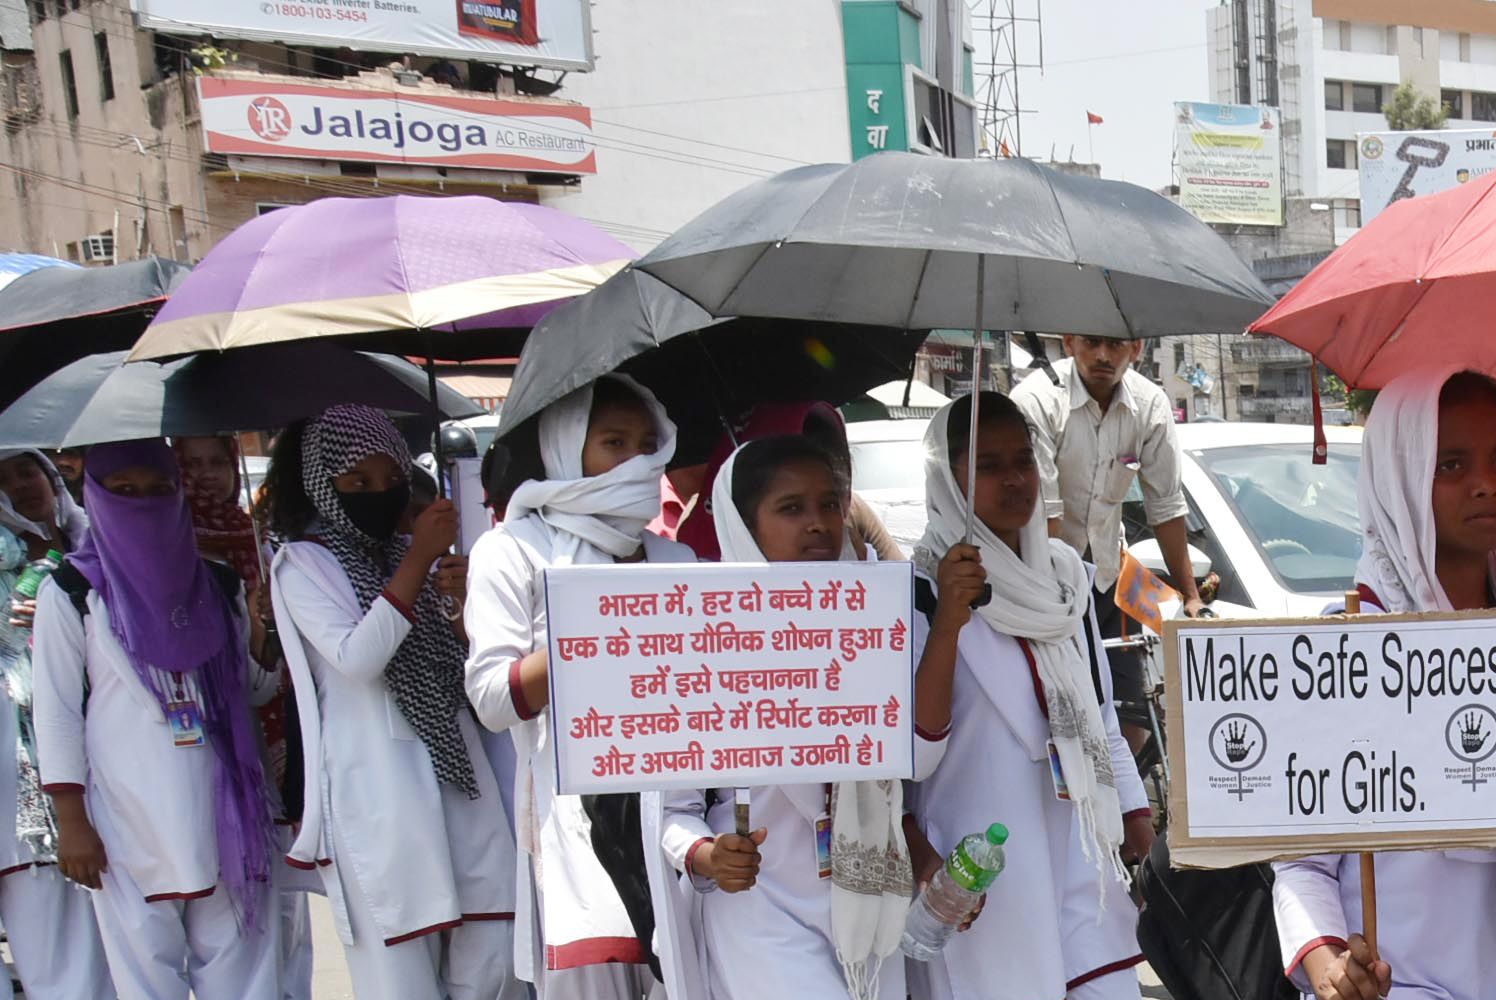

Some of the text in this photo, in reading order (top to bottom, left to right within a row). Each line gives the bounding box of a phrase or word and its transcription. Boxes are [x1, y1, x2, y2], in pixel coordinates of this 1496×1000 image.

[275, 4, 368, 23] 1800-103-5454
[374, 1, 421, 14] Batteries.
[301, 107, 587, 152] Jalajoga AC Restaurant
[599, 579, 866, 617] भारत में, हर दो बच्चे में से
[557, 617, 908, 662] एक के साथ यौनिक शोषन हुआ है
[630, 657, 842, 699] हमें इसे पहचानना है
[1185, 636, 1280, 702] Make
[1291, 633, 1369, 701] Safe
[570, 706, 615, 739] और
[619, 704, 681, 739] इसके
[686, 701, 726, 732] बारे
[729, 700, 753, 730] में
[817, 704, 877, 727] करना
[882, 695, 901, 728] है
[592, 744, 637, 777] और
[640, 740, 704, 775] अपनी
[710, 745, 784, 770] आवाज
[790, 733, 851, 768] उठानी
[1284, 749, 1426, 816] for Girls.
